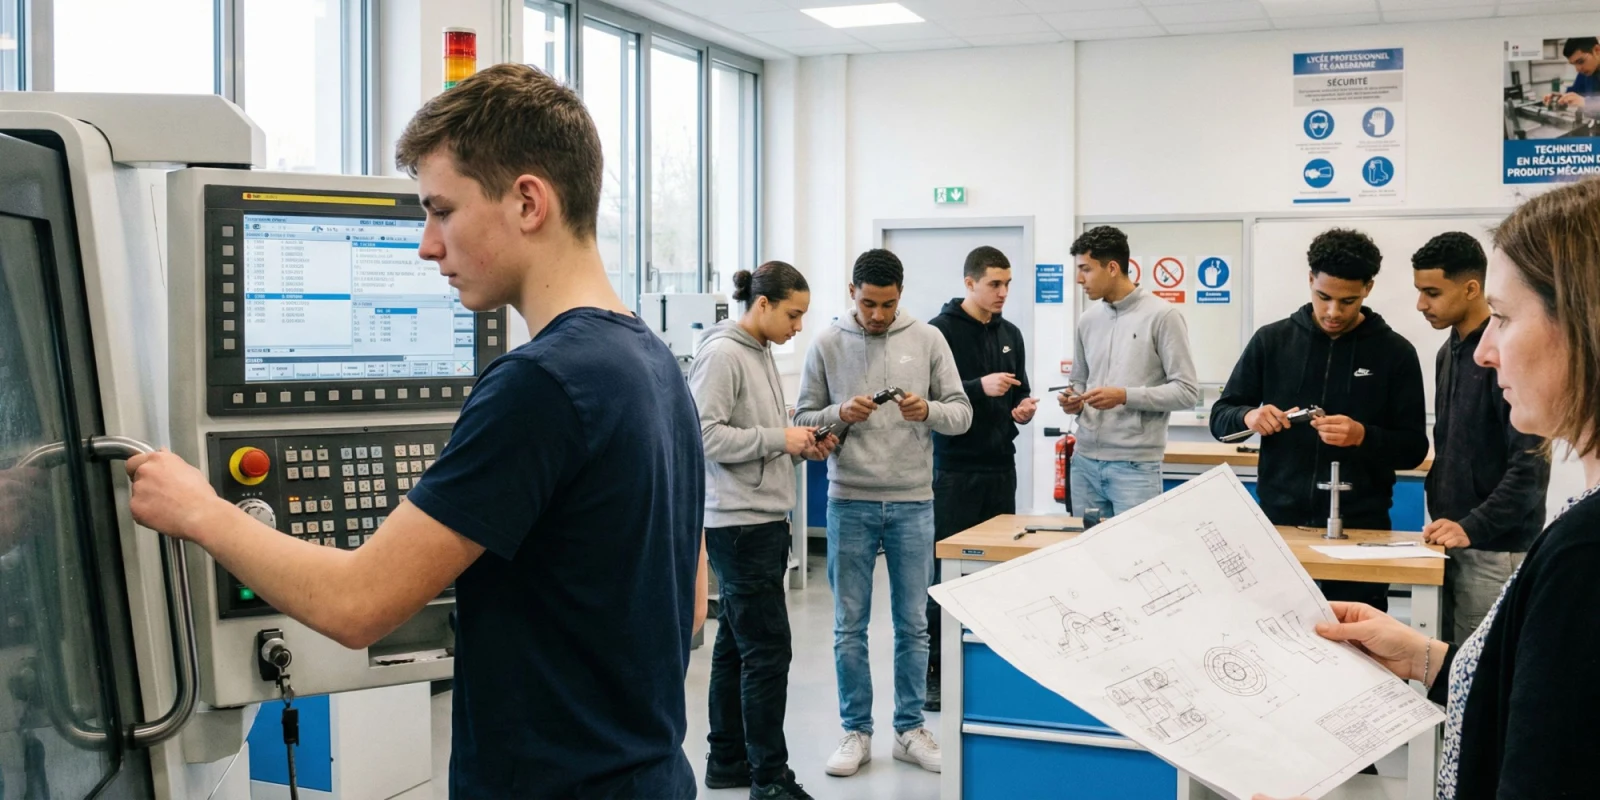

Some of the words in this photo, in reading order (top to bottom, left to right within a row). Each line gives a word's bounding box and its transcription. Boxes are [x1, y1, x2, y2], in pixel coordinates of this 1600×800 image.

[1327, 77, 1368, 87] SÉCURITÉ
[1534, 144, 1592, 154] TECHNICIEN
[1517, 157, 1530, 166] EN
[1532, 155, 1594, 165] RÉALISATION
[1507, 167, 1555, 177] PRODUITS
